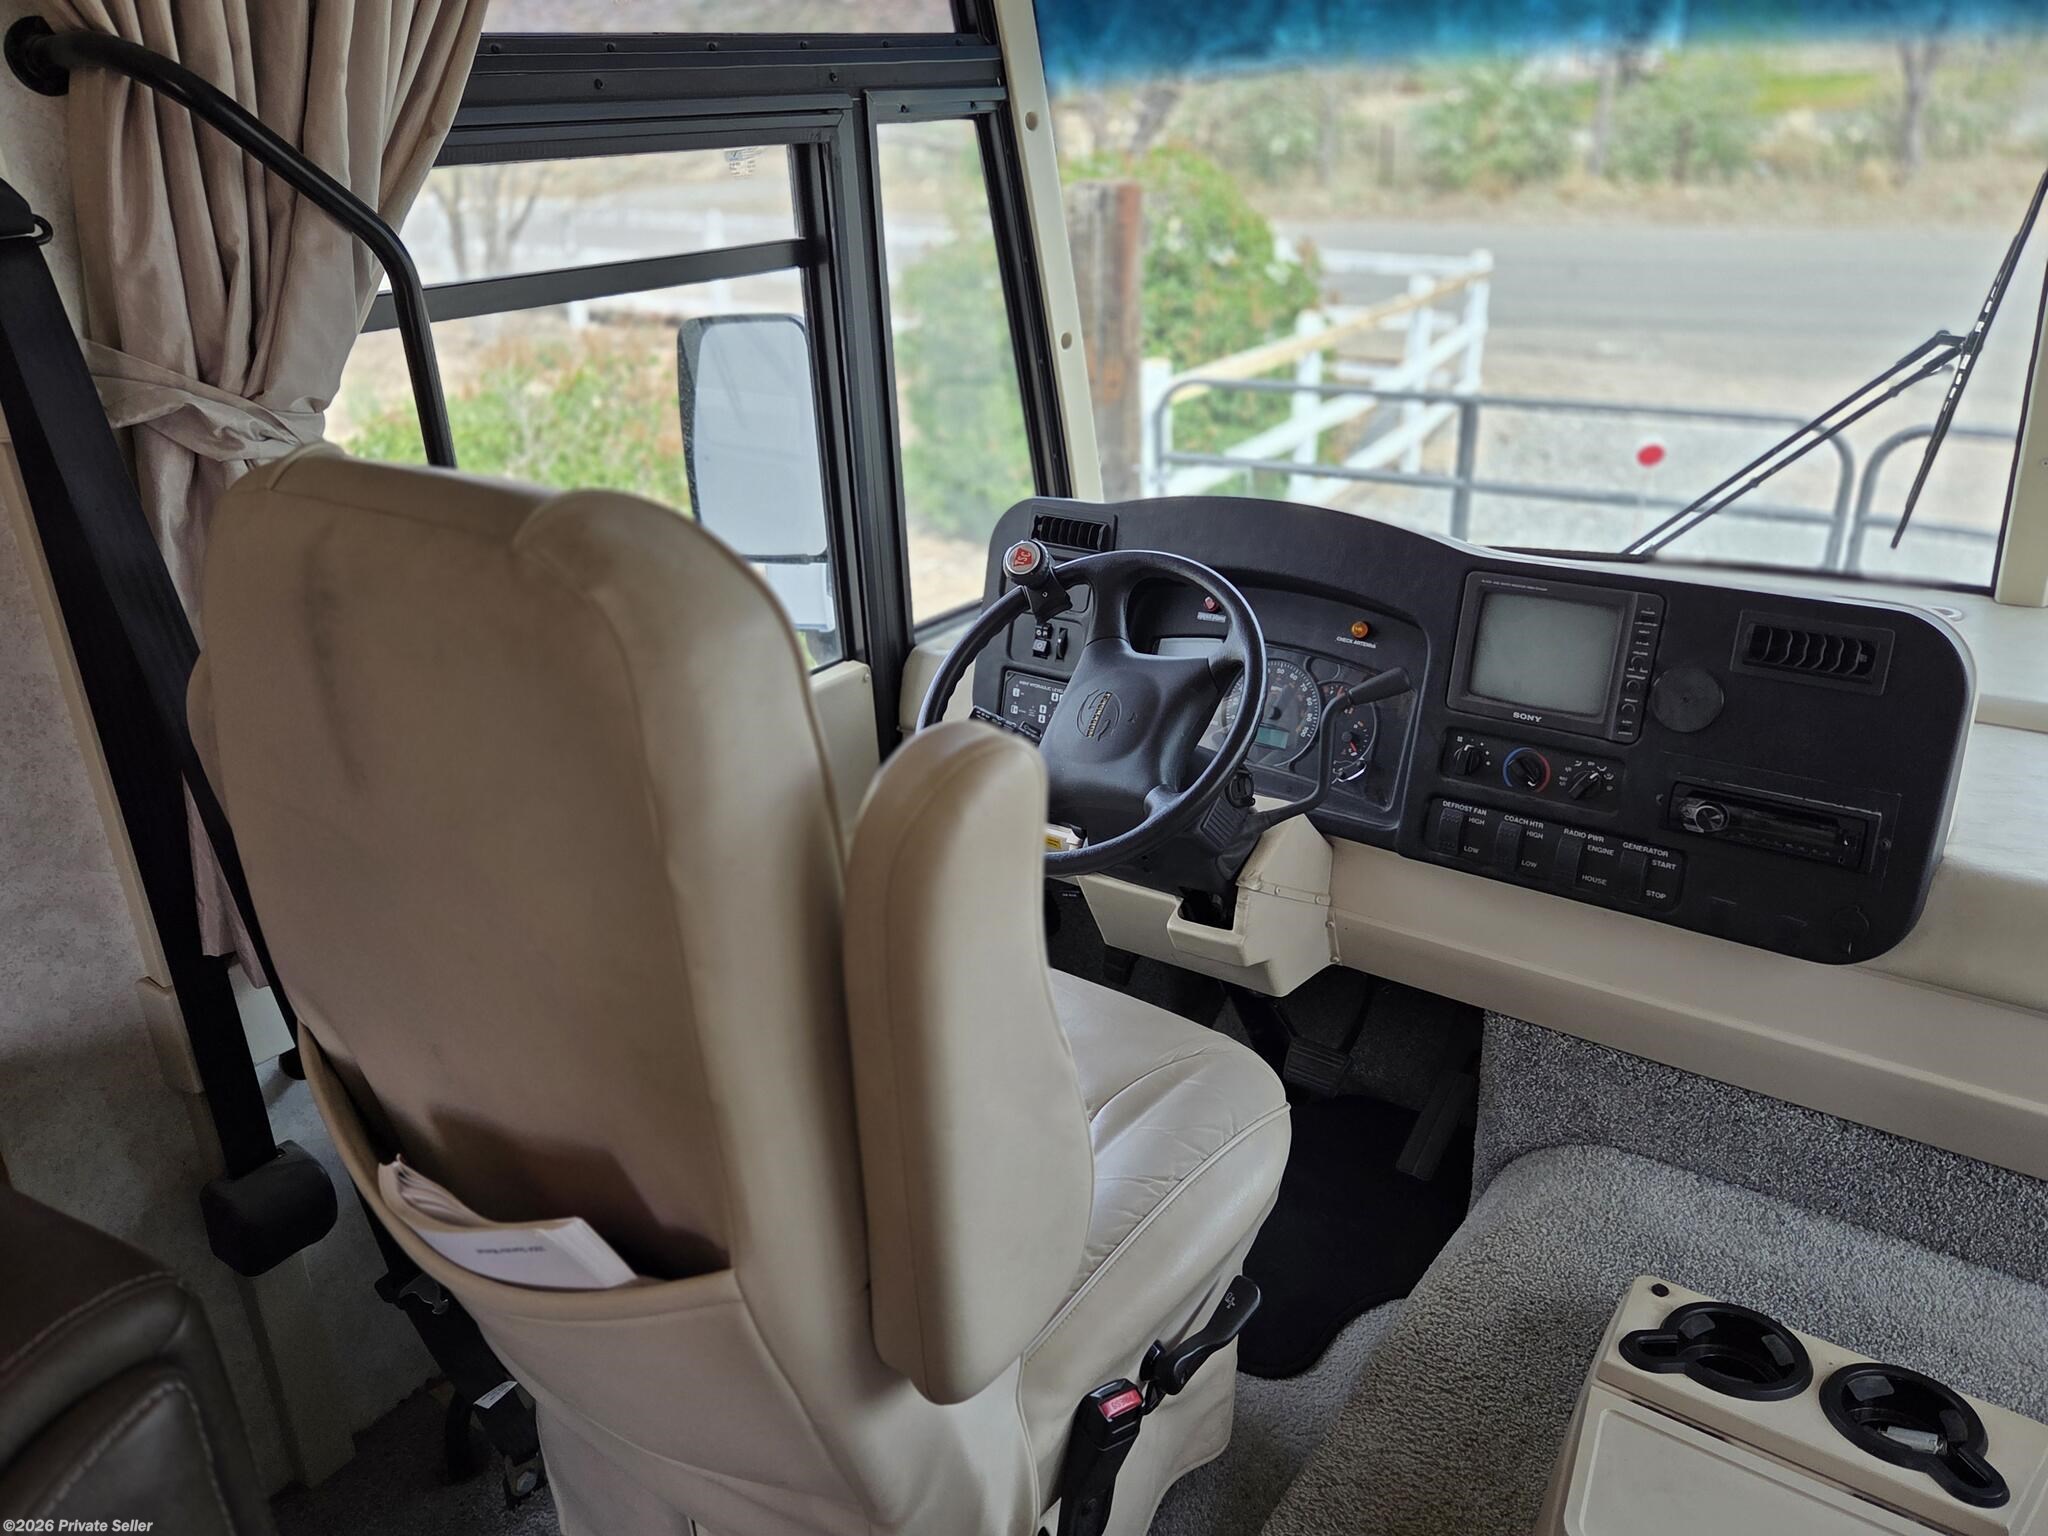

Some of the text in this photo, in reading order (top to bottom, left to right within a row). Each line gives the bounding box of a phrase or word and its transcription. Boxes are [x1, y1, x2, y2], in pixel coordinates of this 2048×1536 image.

[1014, 551, 1031, 565] TSC
[1336, 636, 1353, 645] CHECK
[1289, 672, 1298, 681] 60
[1300, 683, 1308, 692] 70
[1306, 697, 1313, 706] 80
[1306, 713, 1313, 722] 90
[1513, 711, 1542, 723] SONY
[1300, 726, 1309, 738] 100
[1442, 800, 1487, 816] DEFROST FAN
[1468, 817, 1485, 826] HIGH
[1504, 814, 1544, 830] COACH HTR
[1526, 830, 1543, 839] HIGH
[1563, 828, 1604, 843] RADIO PWR
[1463, 845, 1480, 854] LOW
[1587, 844, 1614, 856] ENGINE
[1622, 842, 1669, 858] GENERATOR
[1521, 860, 1537, 869] LOW
[1651, 859, 1677, 870] START
[1582, 874, 1607, 886] HOUSE
[1645, 890, 1666, 900] STOP
